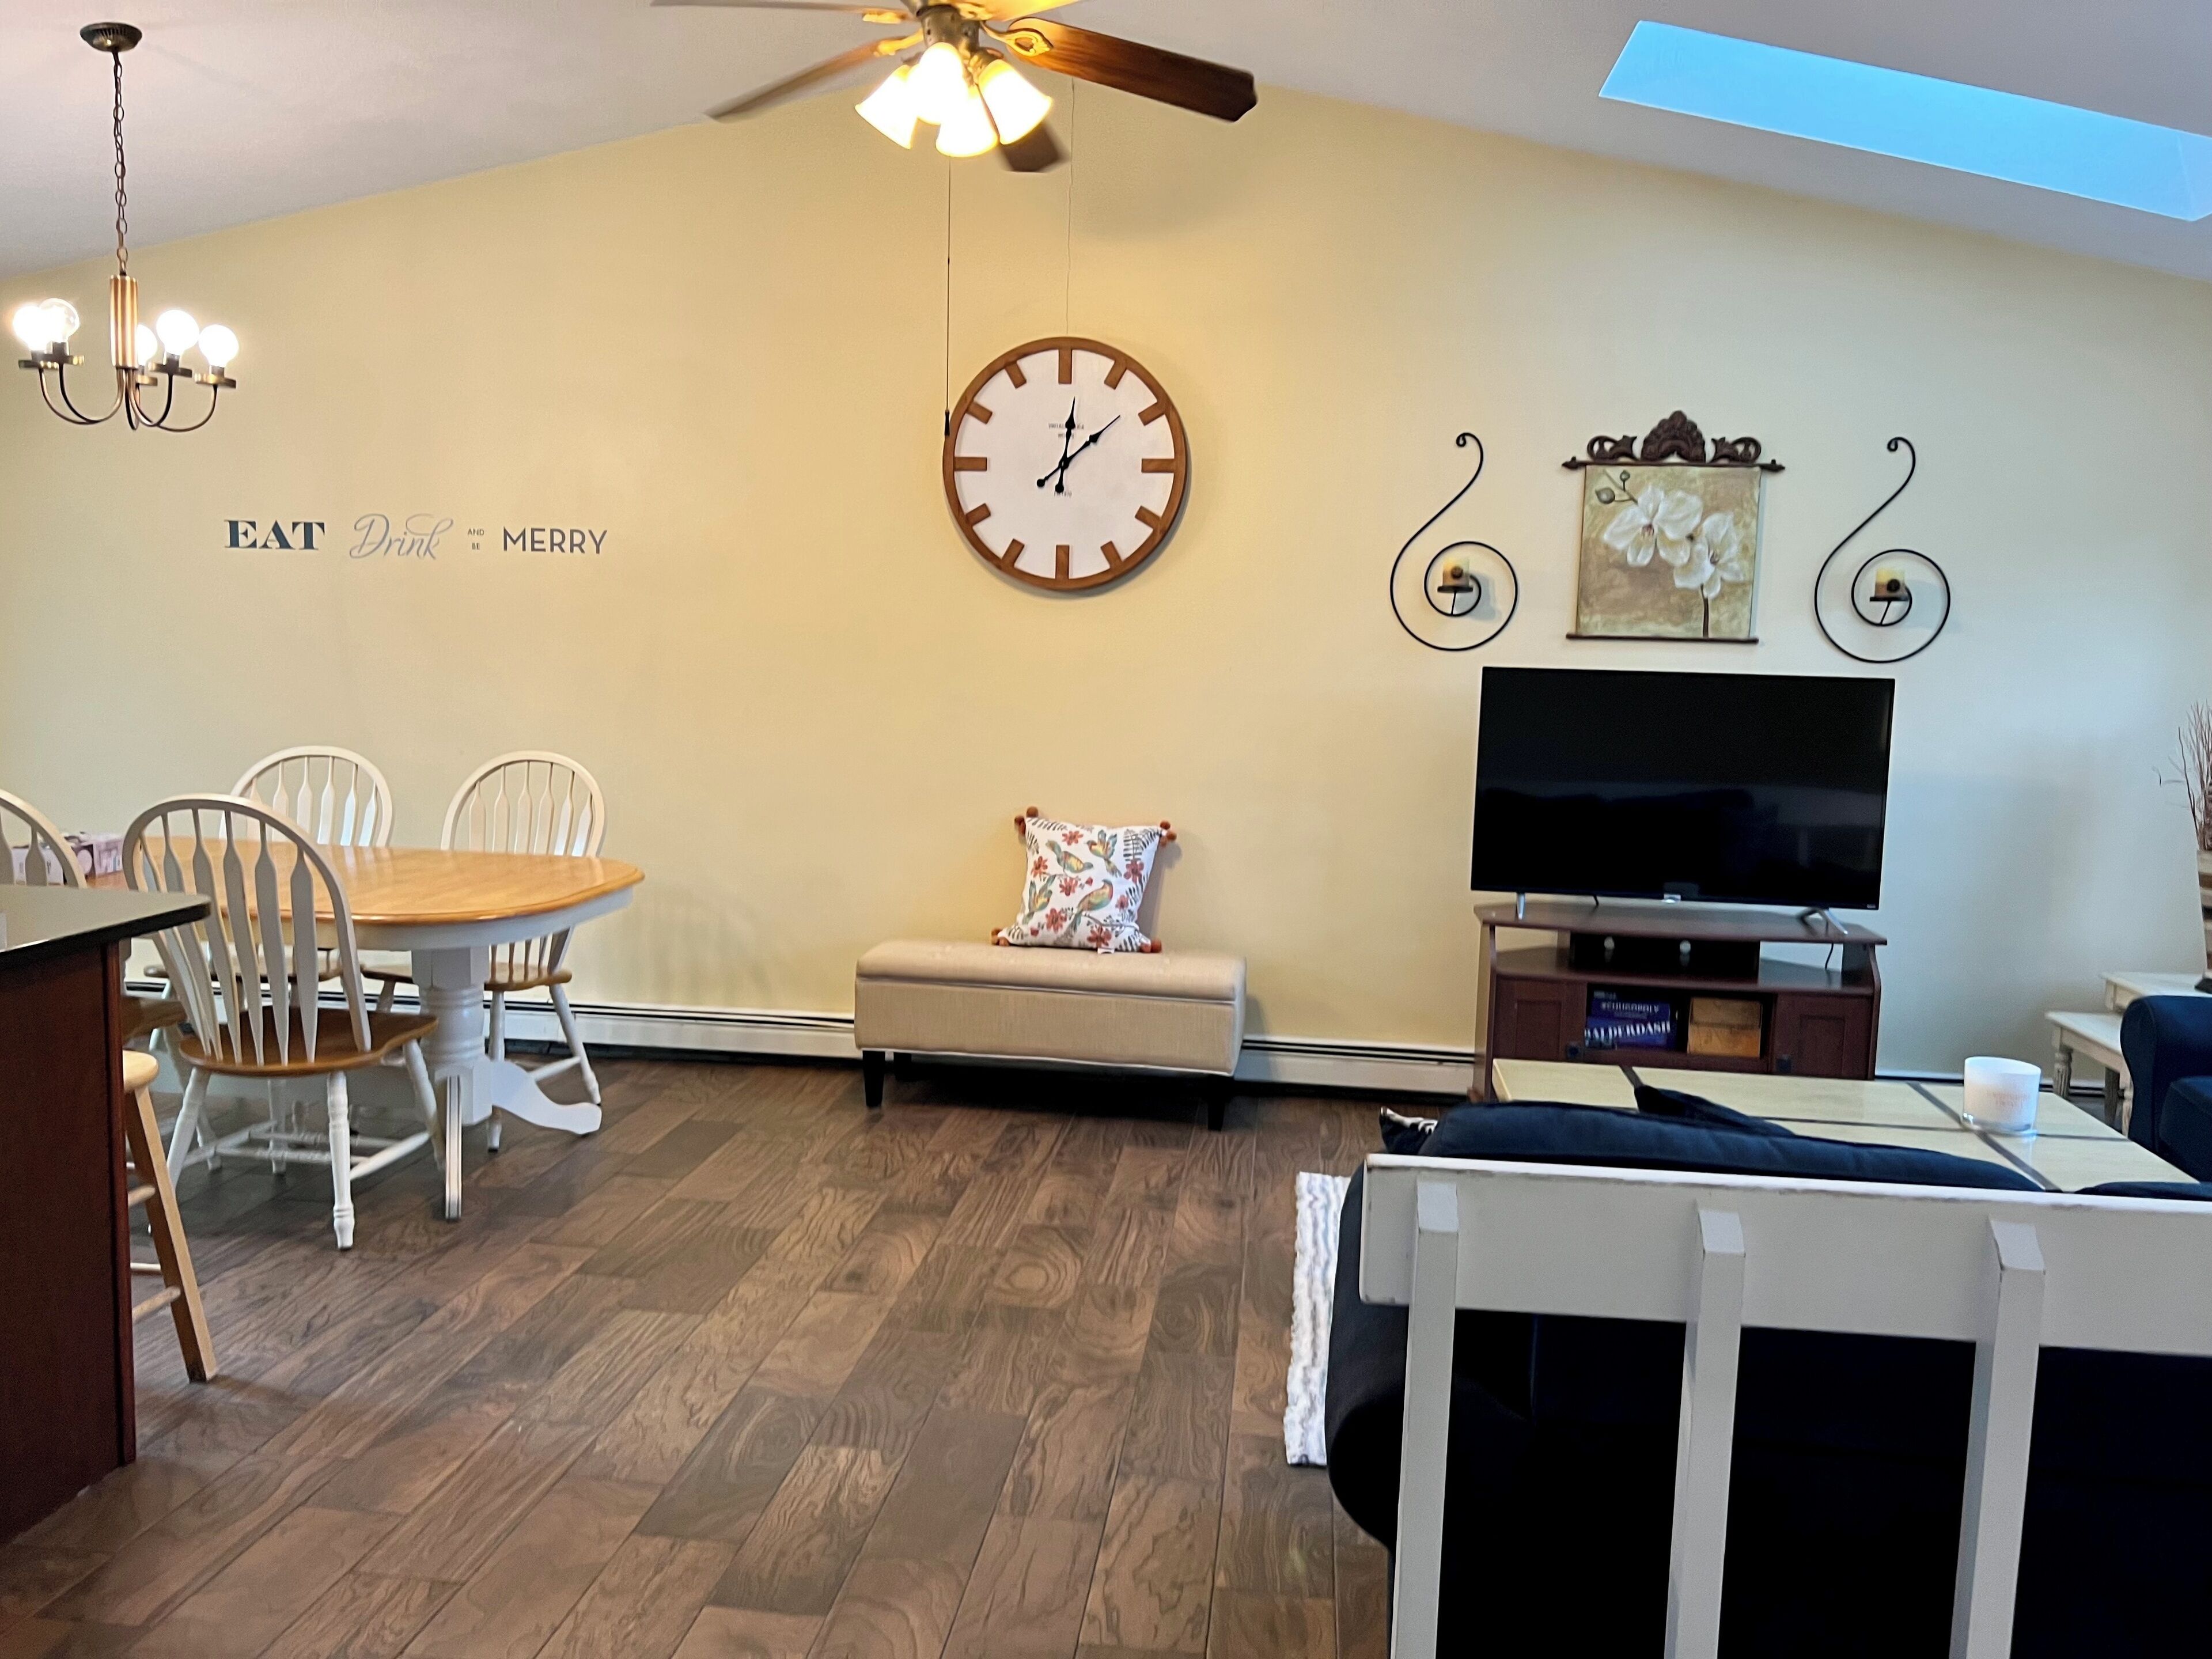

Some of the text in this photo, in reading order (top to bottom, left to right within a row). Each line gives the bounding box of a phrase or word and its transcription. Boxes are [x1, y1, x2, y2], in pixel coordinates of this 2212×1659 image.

[224, 519, 325, 551] EAT
[349, 513, 454, 560] Drink
[467, 528, 484, 536] AND
[503, 527, 608, 554] MERRY
